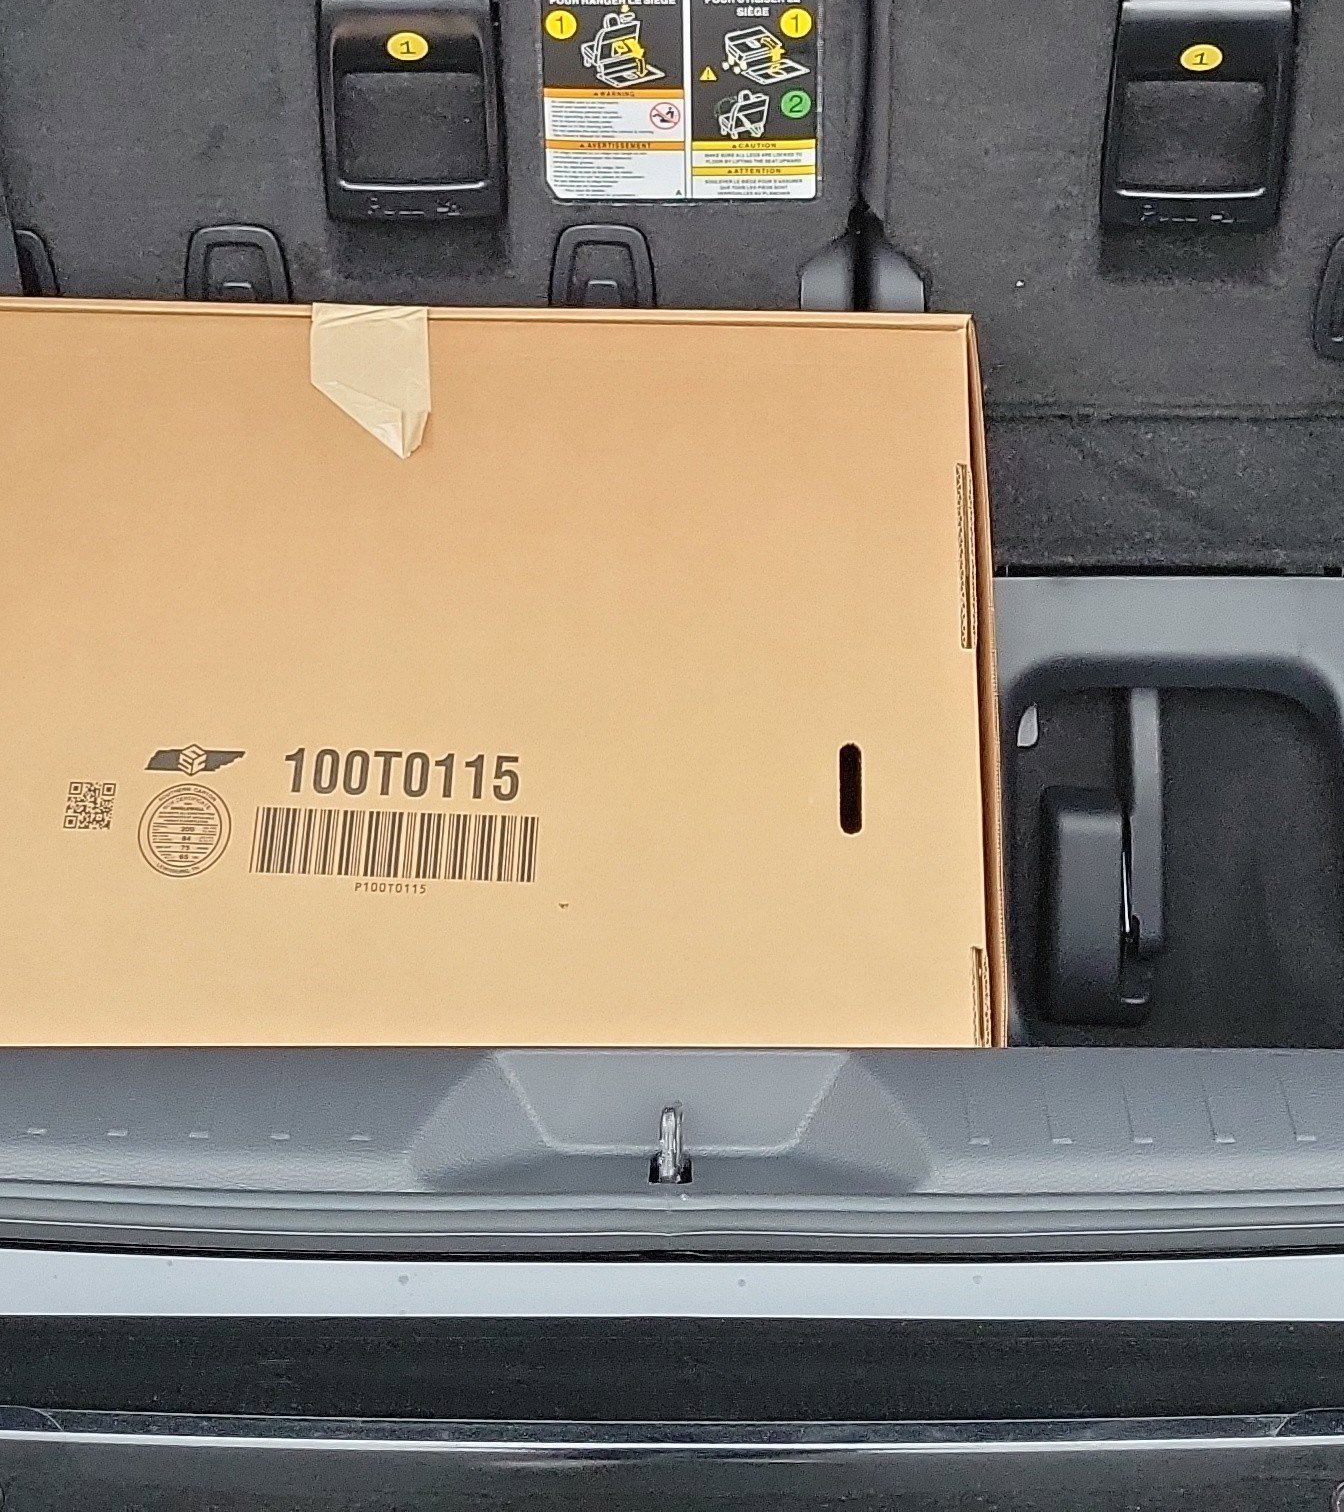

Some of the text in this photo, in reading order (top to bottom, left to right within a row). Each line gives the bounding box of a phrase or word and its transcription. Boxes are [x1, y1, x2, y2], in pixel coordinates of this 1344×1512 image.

[399, 40, 416, 55] 1
[1191, 52, 1208, 65] 1
[788, 94, 803, 113] 2
[284, 747, 520, 802] 100T0115
[354, 882, 427, 895] P100T0115
